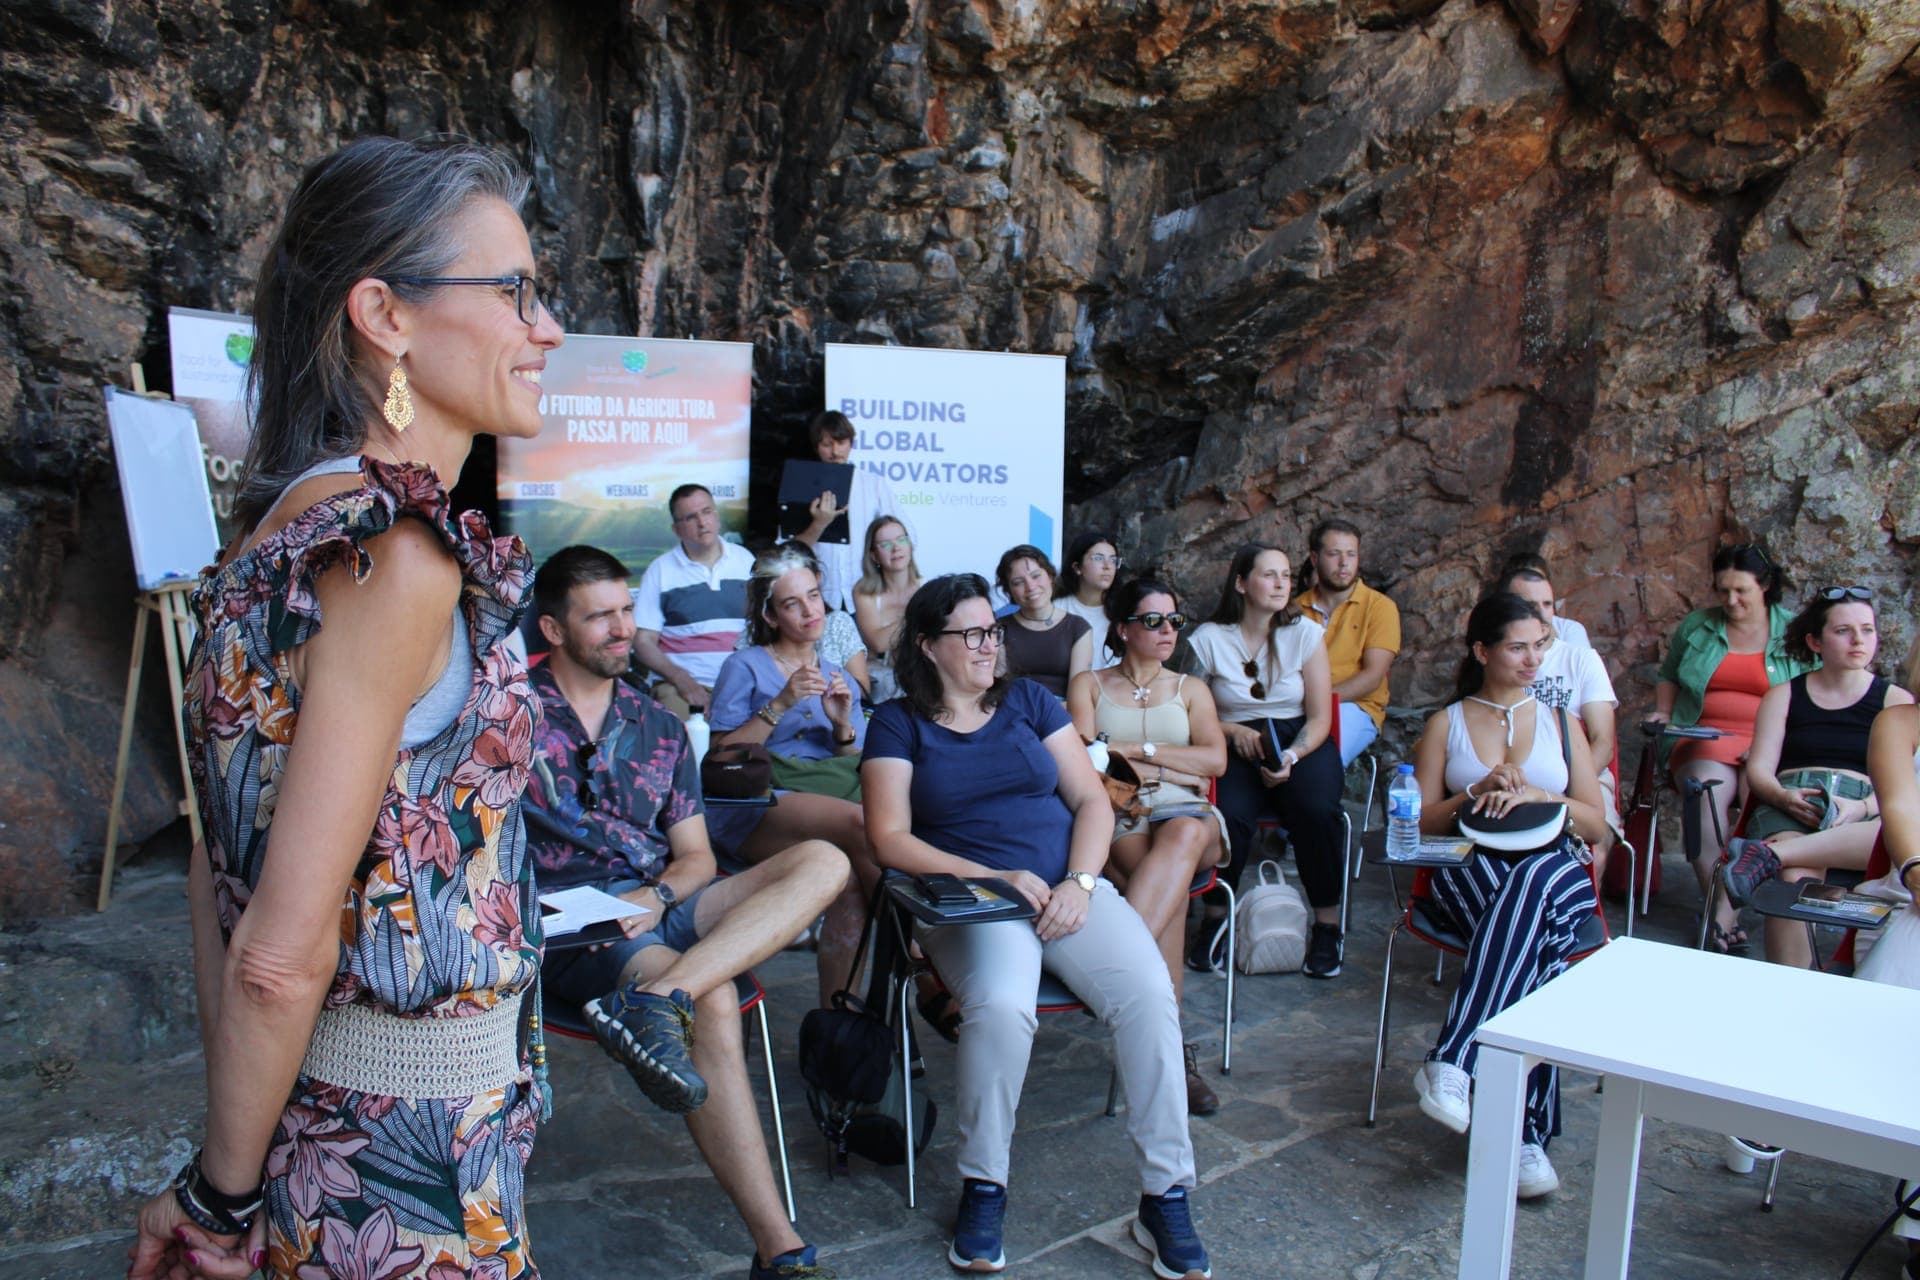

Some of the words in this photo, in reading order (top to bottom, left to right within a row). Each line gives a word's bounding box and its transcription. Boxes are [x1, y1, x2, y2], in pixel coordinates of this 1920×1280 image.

[551, 394, 602, 417] FUTURO
[605, 396, 625, 417] DA
[628, 397, 716, 419] AGRICULTURA
[841, 398, 966, 423] BUILDING
[567, 419, 617, 443] PASSA
[620, 420, 650, 444] POR
[654, 423, 689, 445] AQUI
[521, 483, 556, 497] CURSOS
[605, 484, 649, 498] WEBINARS
[711, 481, 736, 498] ÁRIOS
[939, 490, 1008, 508] Ventures
